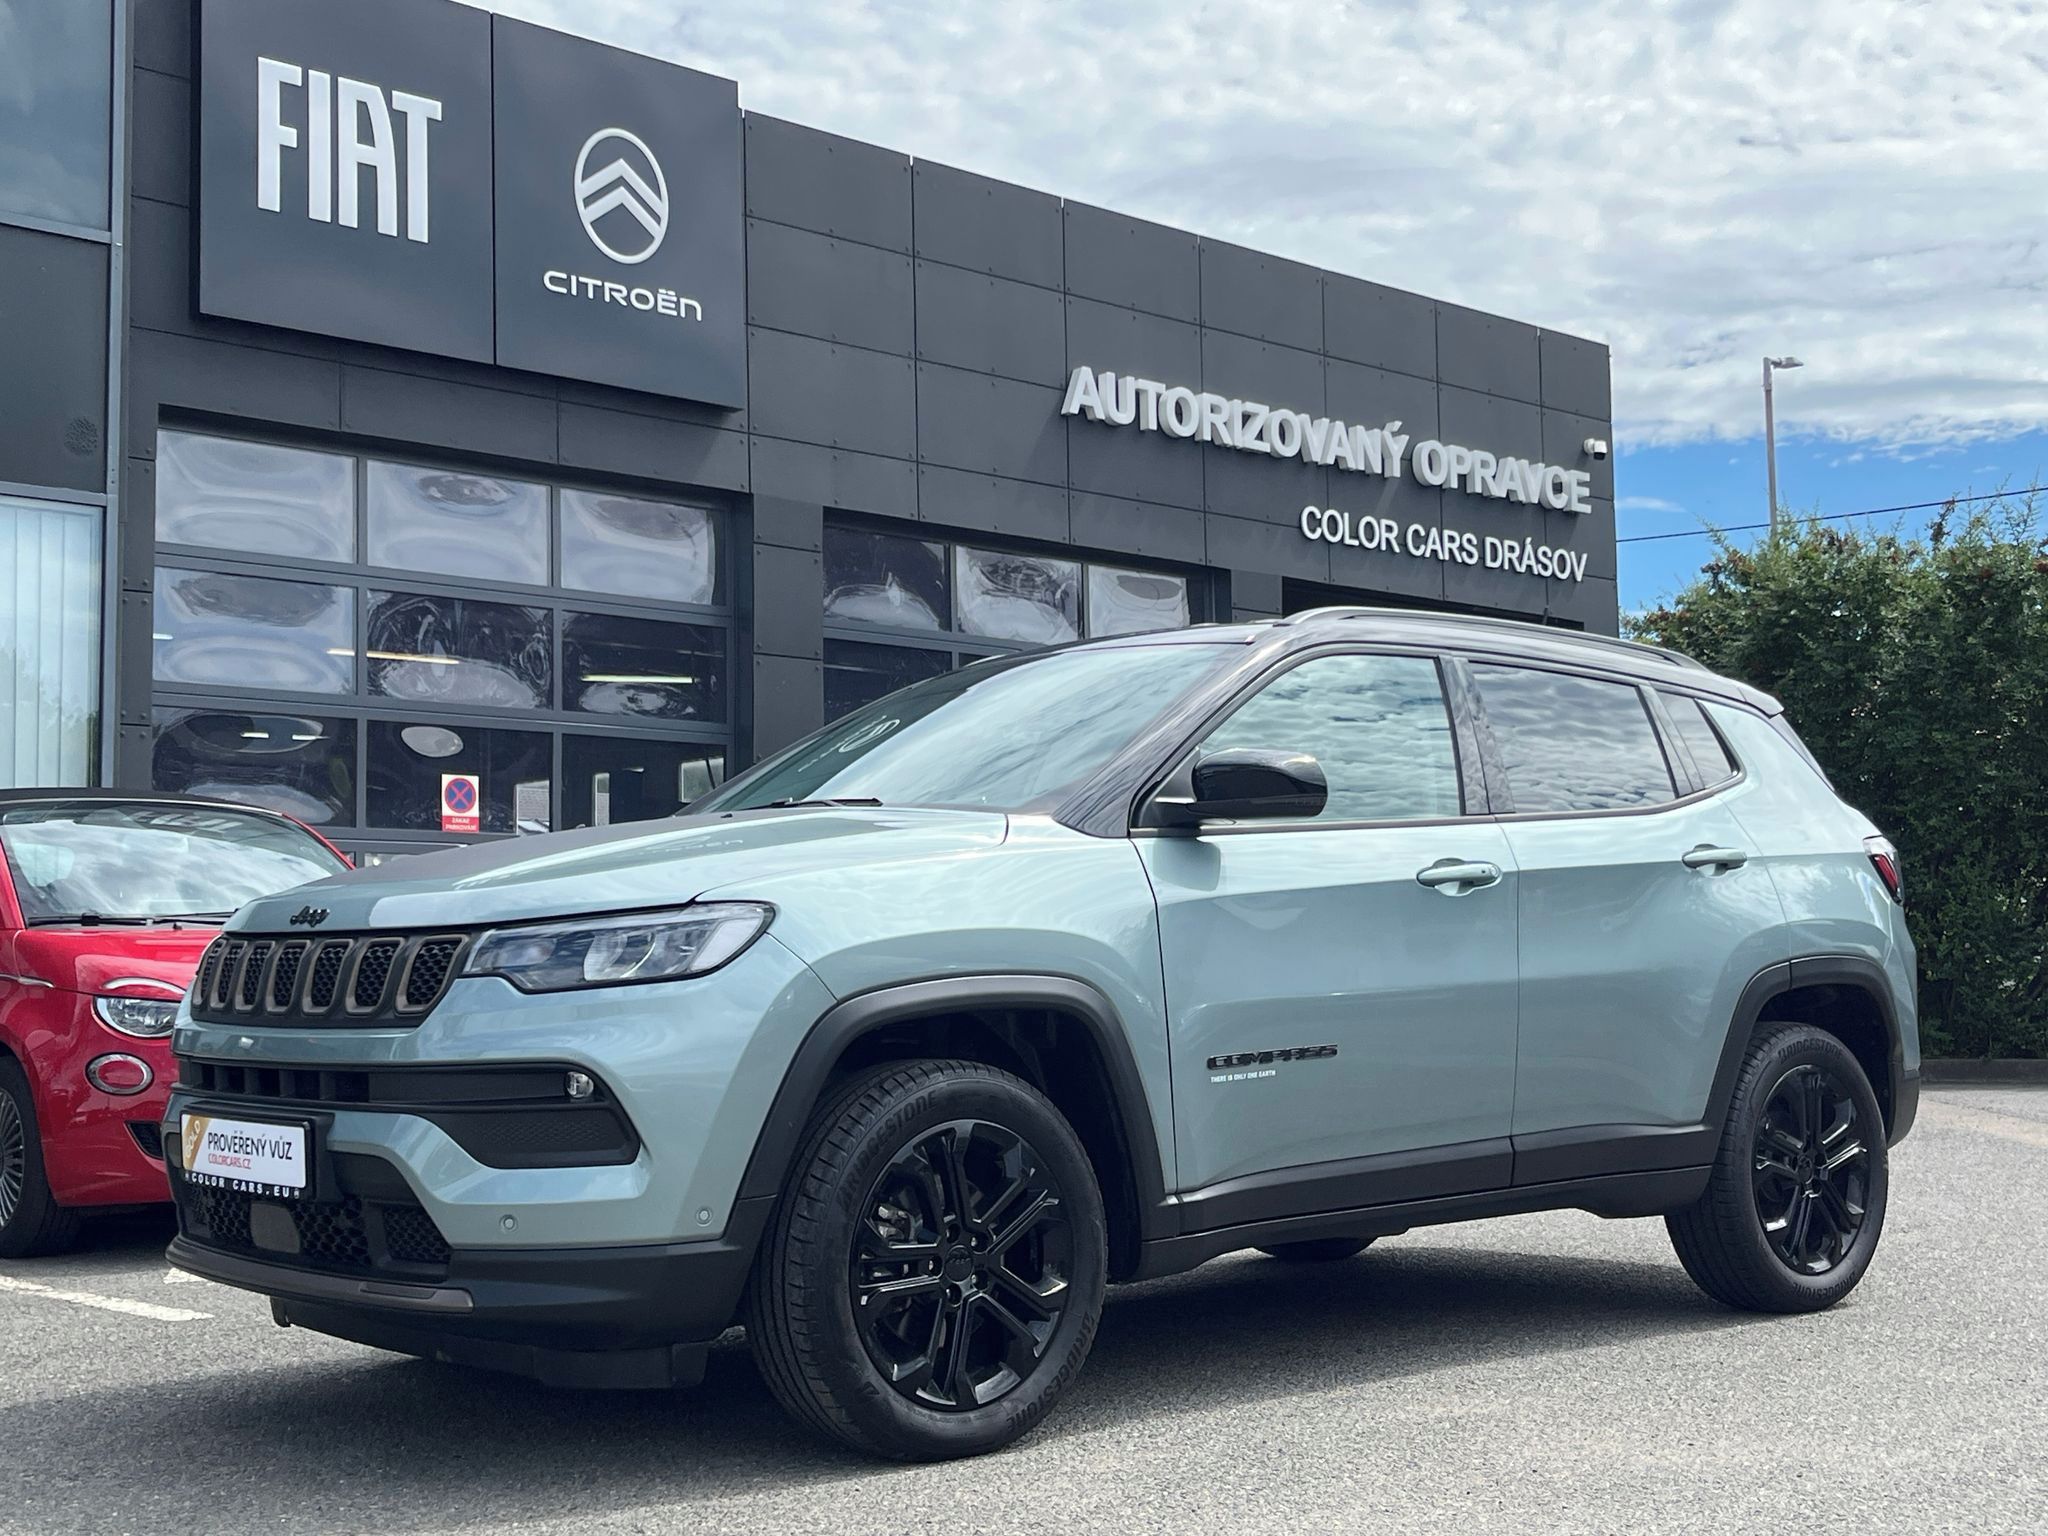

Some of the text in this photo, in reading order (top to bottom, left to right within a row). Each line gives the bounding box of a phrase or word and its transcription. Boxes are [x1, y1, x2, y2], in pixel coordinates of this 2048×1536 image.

[257, 57, 442, 243] FIAT
[1061, 366, 1592, 514] AUTORIZOVANÝ OPRAVCE
[1300, 505, 1588, 582] COLOR CARS DRÁSOV
[207, 1130, 293, 1160] PROVĚŘENÝ VŮZ
[207, 1153, 252, 1170] COLORCARS.CZ
[191, 1172, 290, 1198] COLOR CARS.EU
